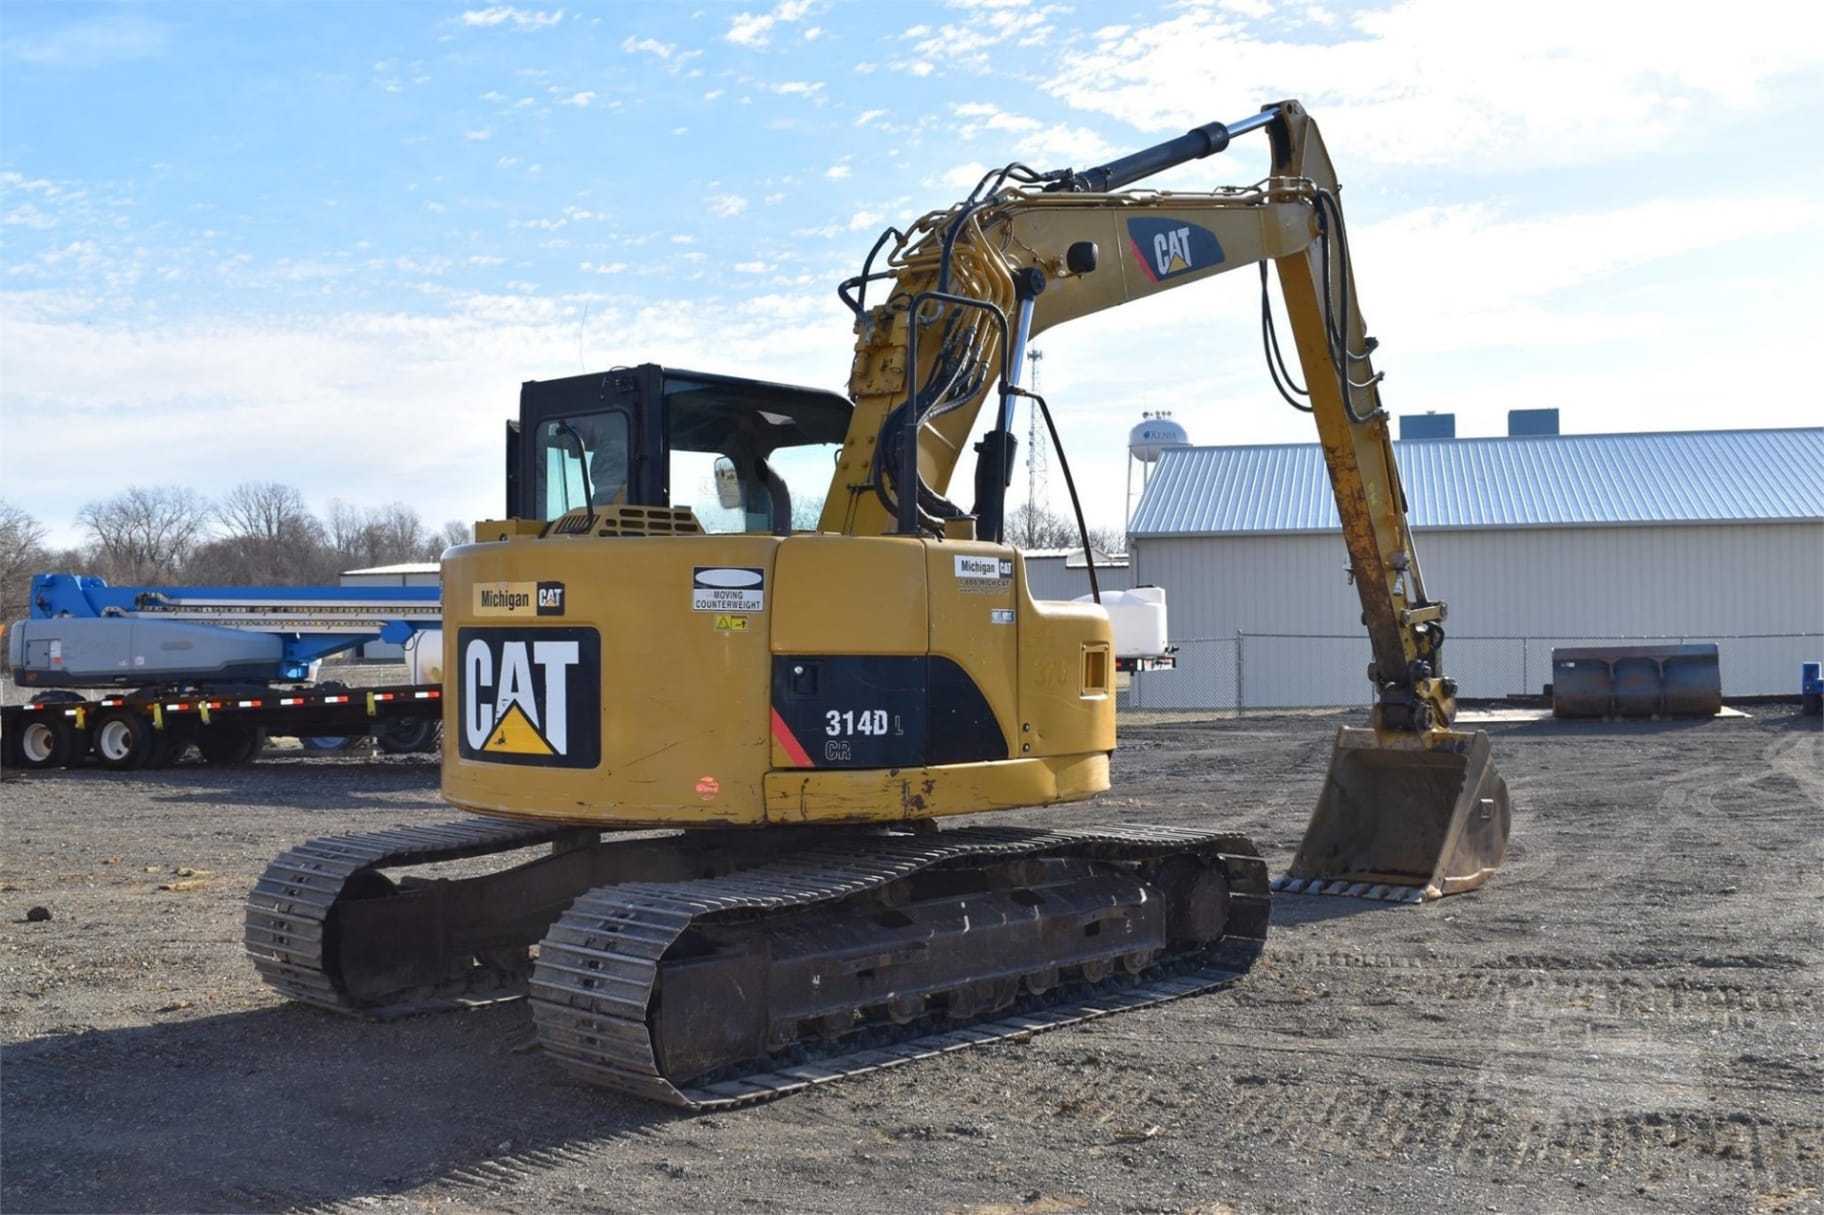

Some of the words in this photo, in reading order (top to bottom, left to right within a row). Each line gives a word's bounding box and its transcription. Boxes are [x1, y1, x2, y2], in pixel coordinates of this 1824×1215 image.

[1153, 227, 1192, 275] CAT
[961, 560, 995, 575] Michigan
[999, 562, 1012, 574] CAT
[481, 589, 529, 611] Michigan
[539, 588, 563, 607] CAT
[695, 600, 761, 609] COUNTERWEIGHT
[713, 591, 743, 600] MOVING
[465, 639, 579, 755] CAT
[825, 709, 888, 736] 314D
[824, 740, 852, 761] CR
